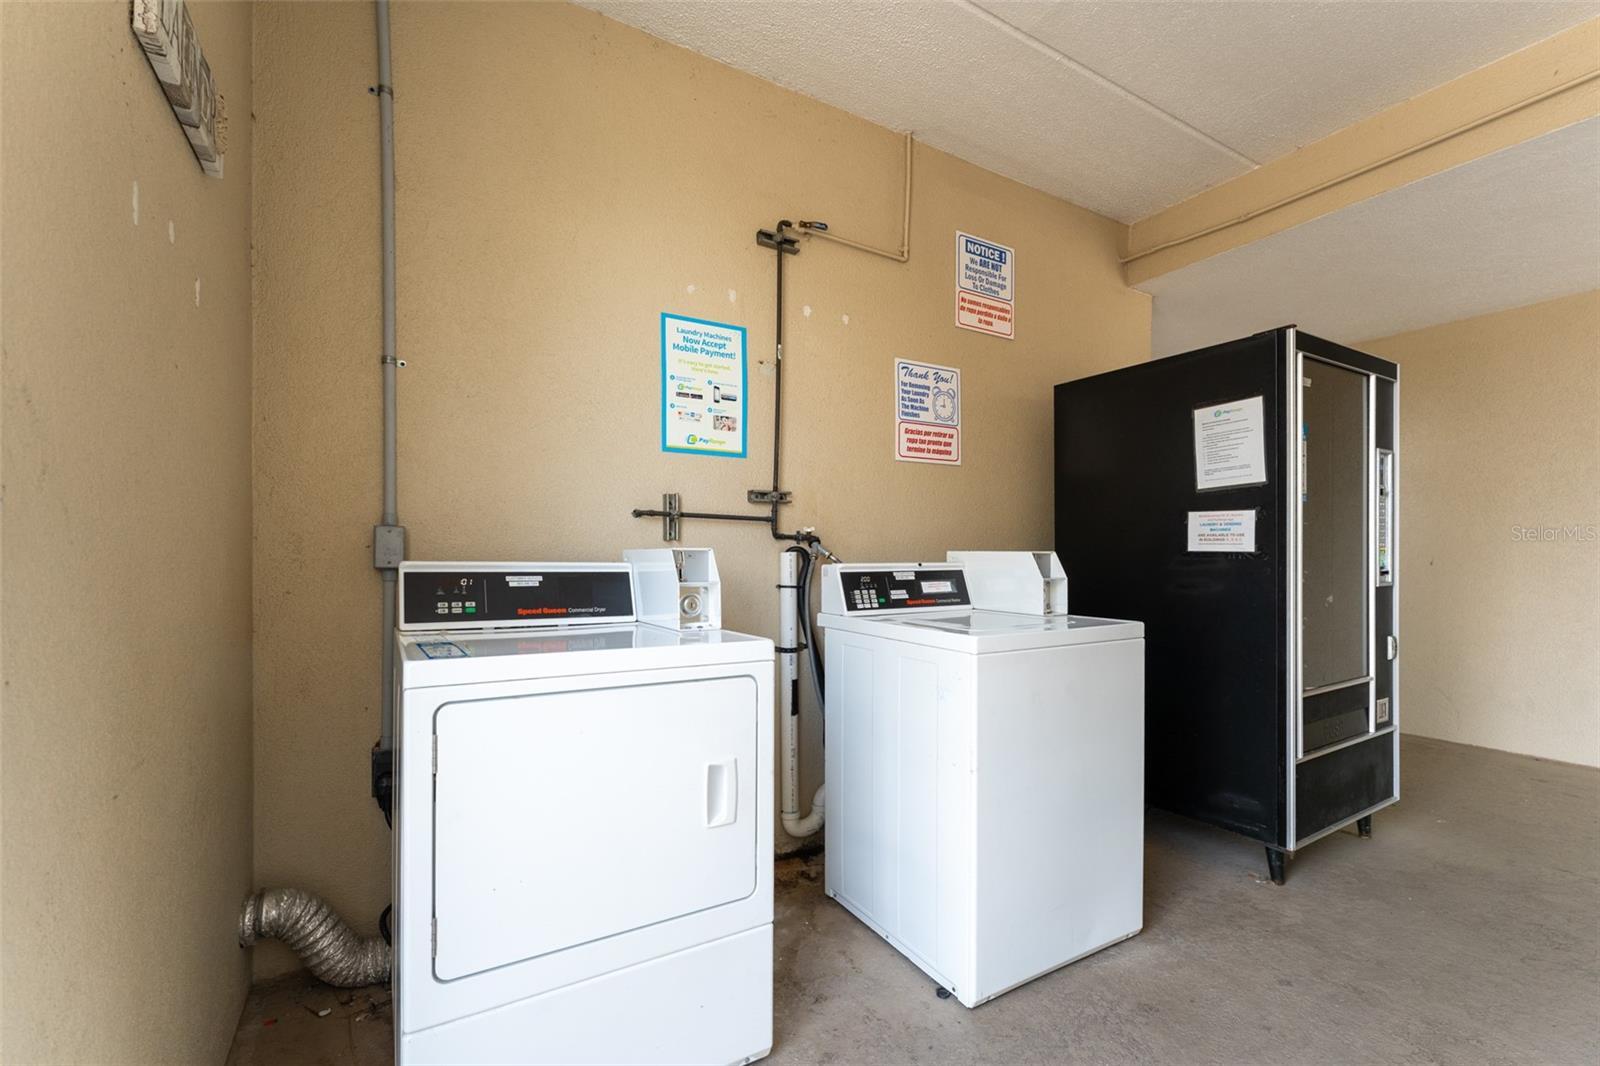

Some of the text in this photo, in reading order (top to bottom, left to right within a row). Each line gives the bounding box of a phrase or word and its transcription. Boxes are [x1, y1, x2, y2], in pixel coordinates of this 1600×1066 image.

[967, 241, 1000, 261] NOTICE
[970, 257, 1002, 272] We ARE NOT
[965, 263, 1006, 282] Responsible For
[965, 271, 977, 282] Loss
[986, 278, 1006, 290] Damage
[980, 284, 1000, 296] Clothes
[960, 296, 1010, 314] No somos responsables
[676, 327, 732, 342] Laundry Machines
[682, 336, 726, 350] Now Accept
[672, 343, 736, 360] Mobile Payment!
[901, 366, 954, 384] Thank You!
[909, 382, 930, 392] Removing
[912, 390, 929, 398] Laundry
[901, 410, 920, 418] Finishes
[910, 404, 929, 412] Machine
[905, 428, 923, 436] Gracias
